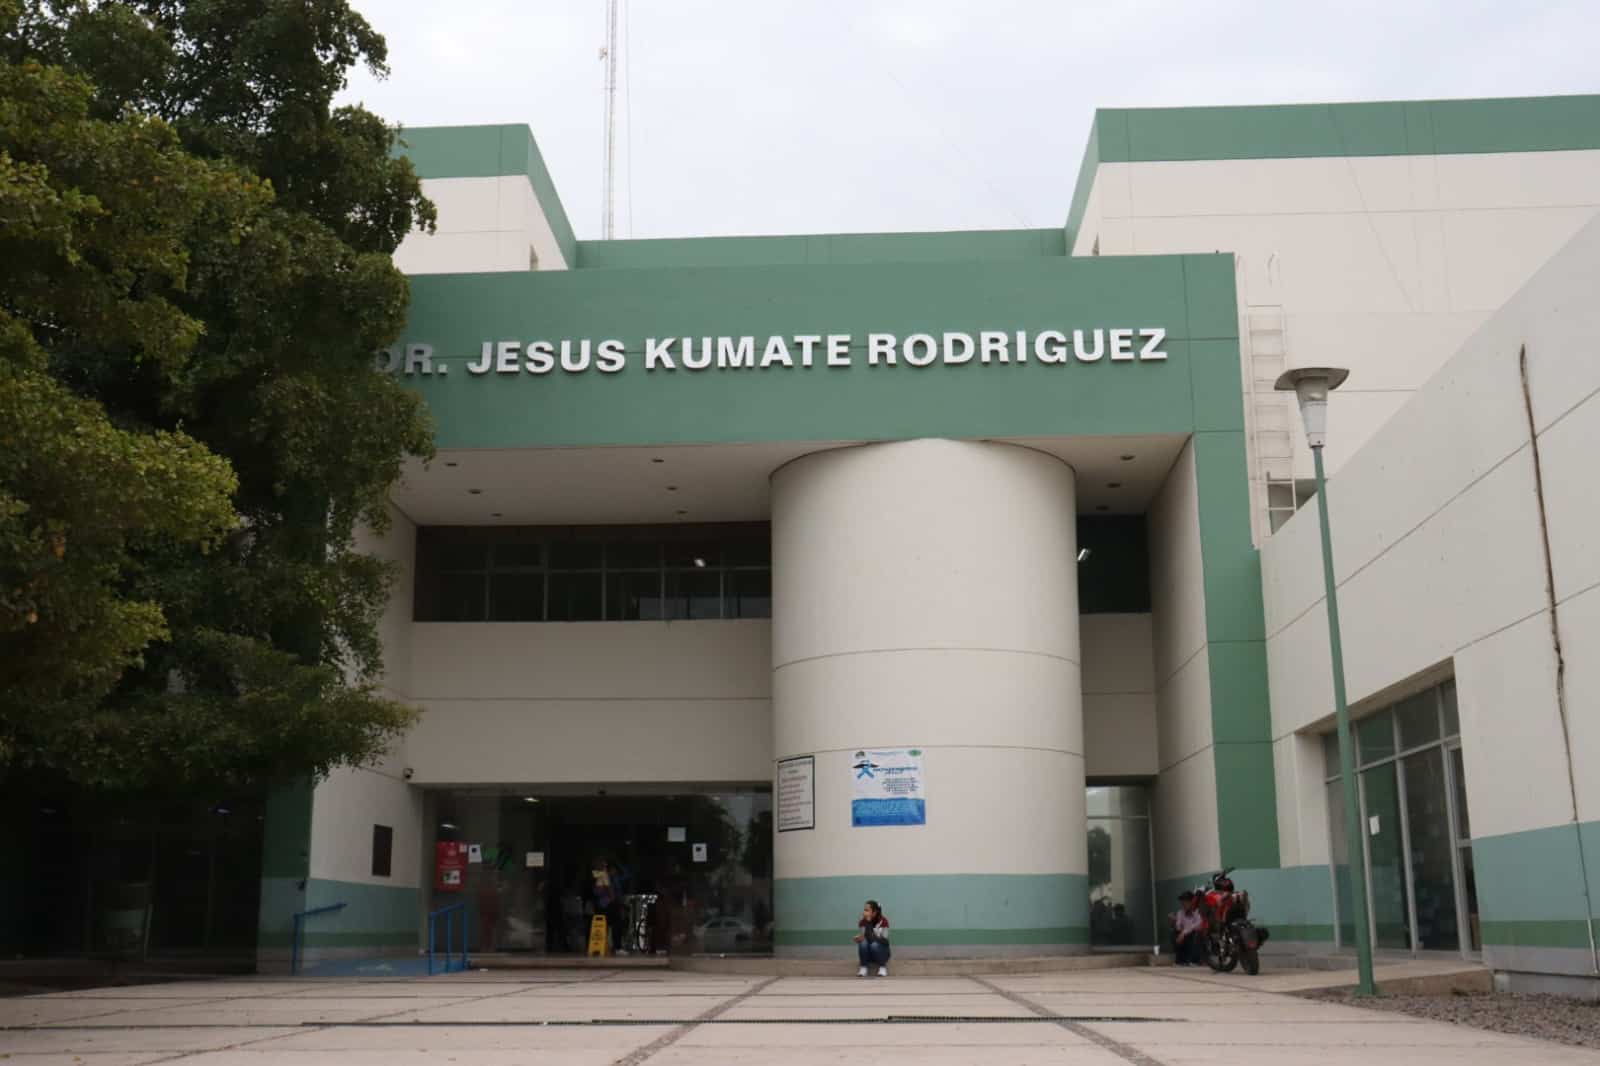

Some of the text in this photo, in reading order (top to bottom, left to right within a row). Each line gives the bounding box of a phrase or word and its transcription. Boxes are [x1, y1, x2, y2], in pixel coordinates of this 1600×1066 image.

[467, 340, 626, 373] JESUS
[645, 335, 852, 370] KUMATE
[868, 328, 1168, 366] RODRIGUEZ
